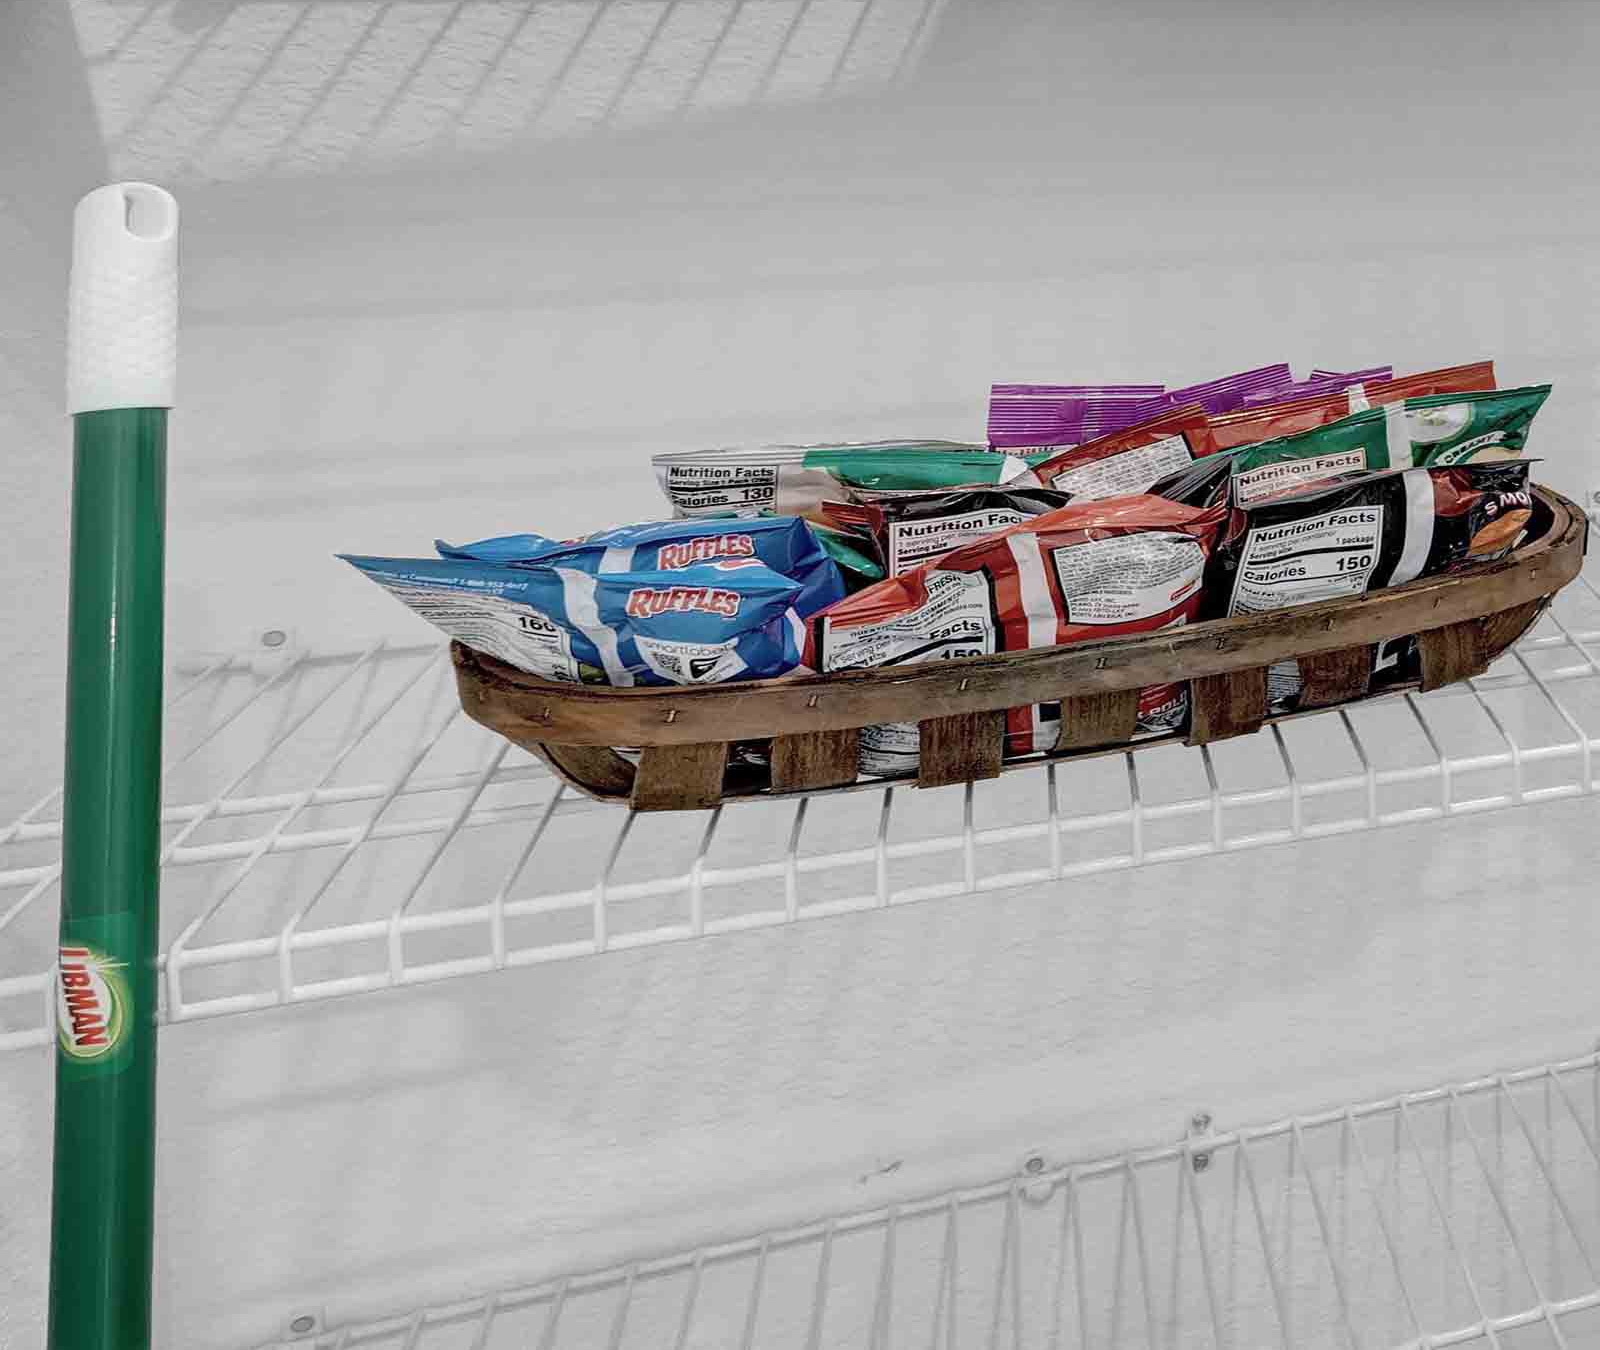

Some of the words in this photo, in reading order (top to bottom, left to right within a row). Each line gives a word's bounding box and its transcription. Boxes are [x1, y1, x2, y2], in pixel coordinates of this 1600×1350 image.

[669, 467, 731, 478] Nutrition
[735, 467, 774, 477] Facts
[1239, 464, 1311, 487] Nutrition
[1316, 454, 1361, 470] Facts
[741, 487, 774, 500] 130
[898, 518, 984, 538] Nutrition
[1255, 520, 1325, 543] Nutrition
[1329, 511, 1377, 527] Facts
[1342, 534, 1374, 546] package
[658, 534, 754, 571] RUFFLES
[1244, 565, 1306, 583] Calories
[1336, 554, 1372, 572] 150
[626, 586, 741, 619] RUFFLES
[929, 619, 982, 640] Facts
[59, 948, 109, 1046] LIBMAN
